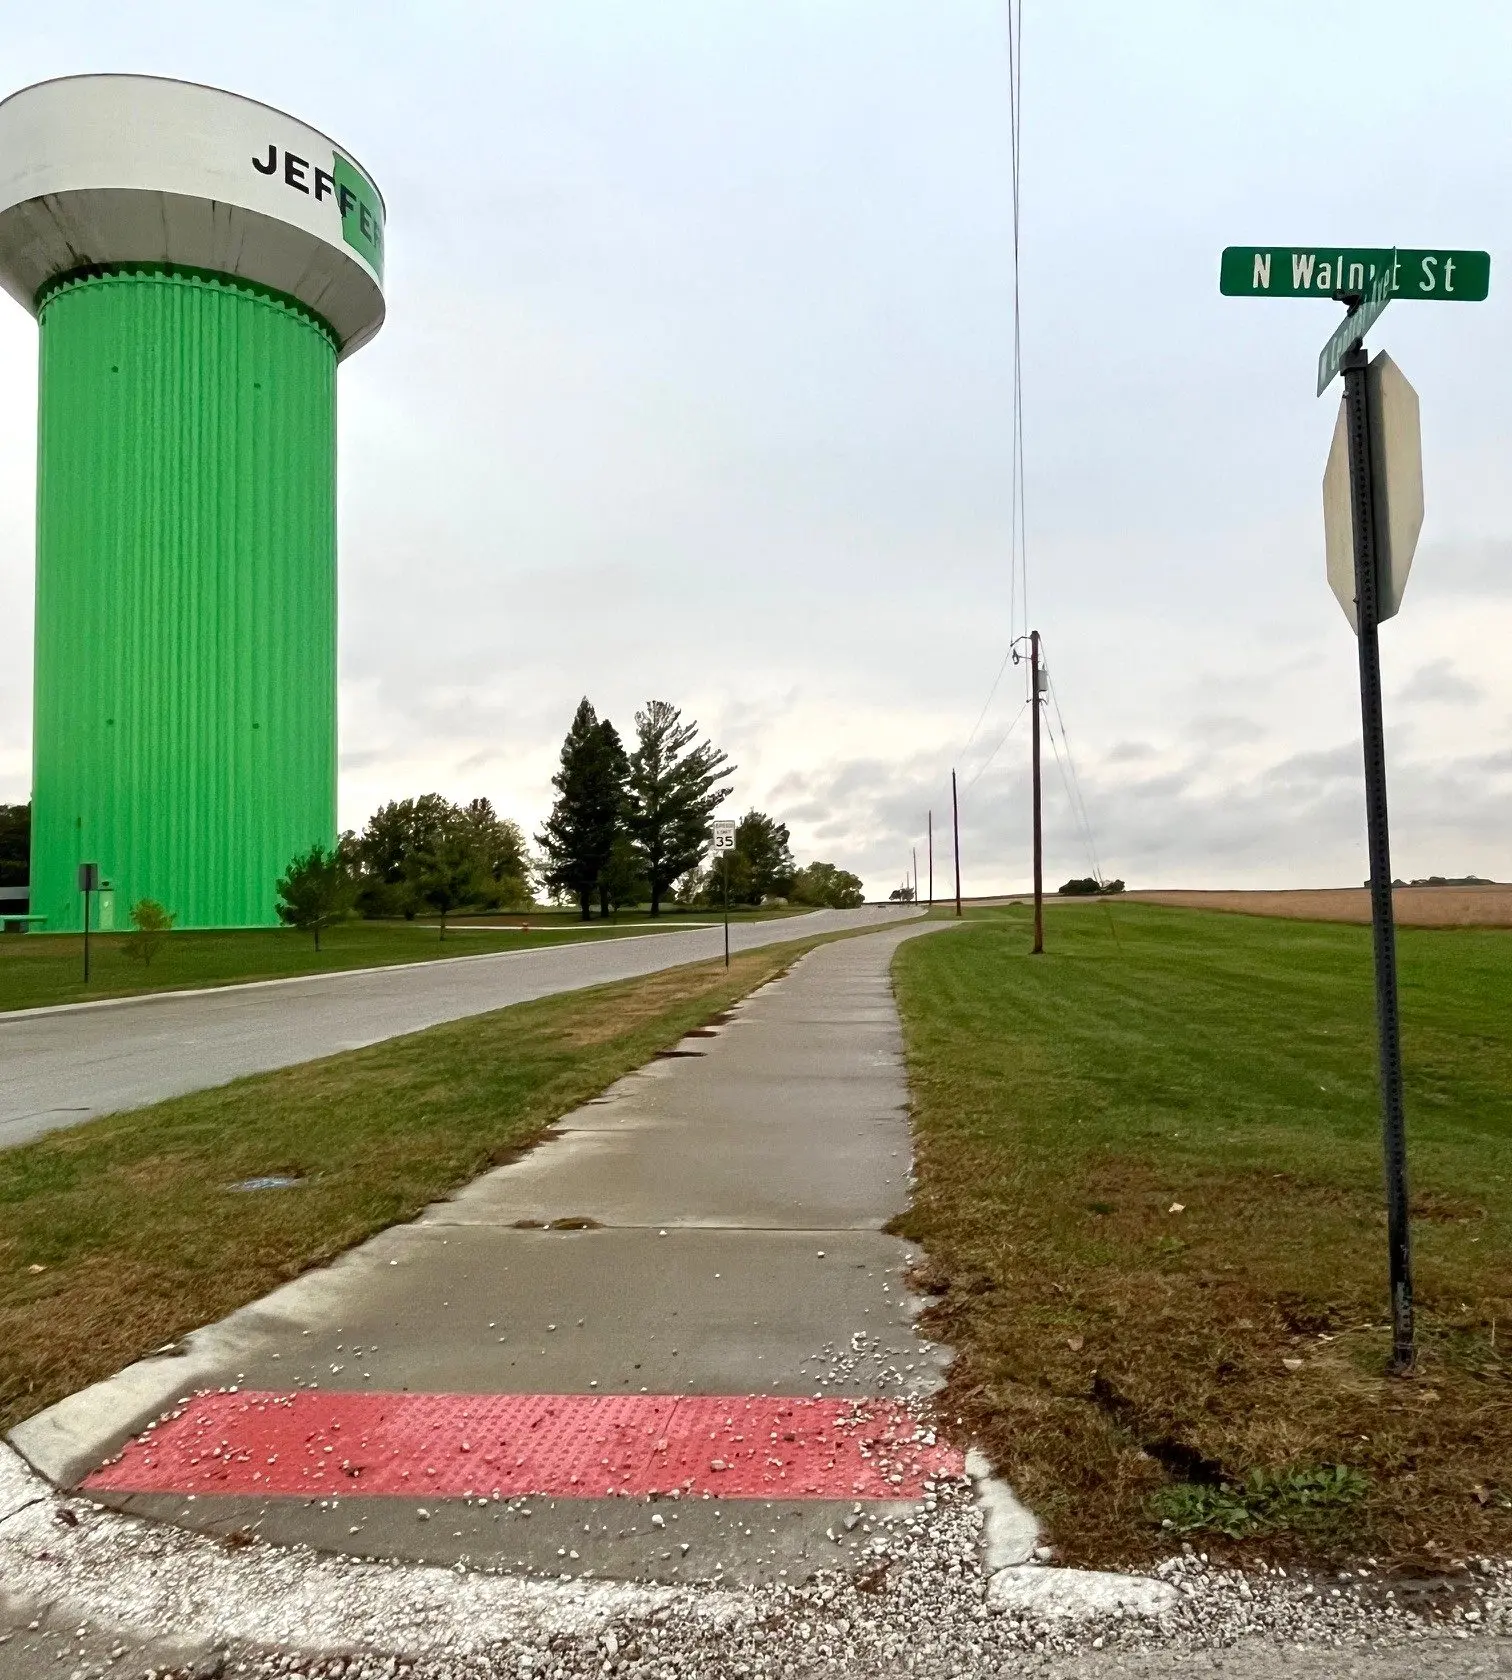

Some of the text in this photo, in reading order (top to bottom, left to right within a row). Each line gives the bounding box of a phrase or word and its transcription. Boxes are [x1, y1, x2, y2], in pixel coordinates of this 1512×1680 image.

[1252, 253, 1272, 289] N
[1418, 256, 1457, 292] St
[716, 836, 734, 847] 35
